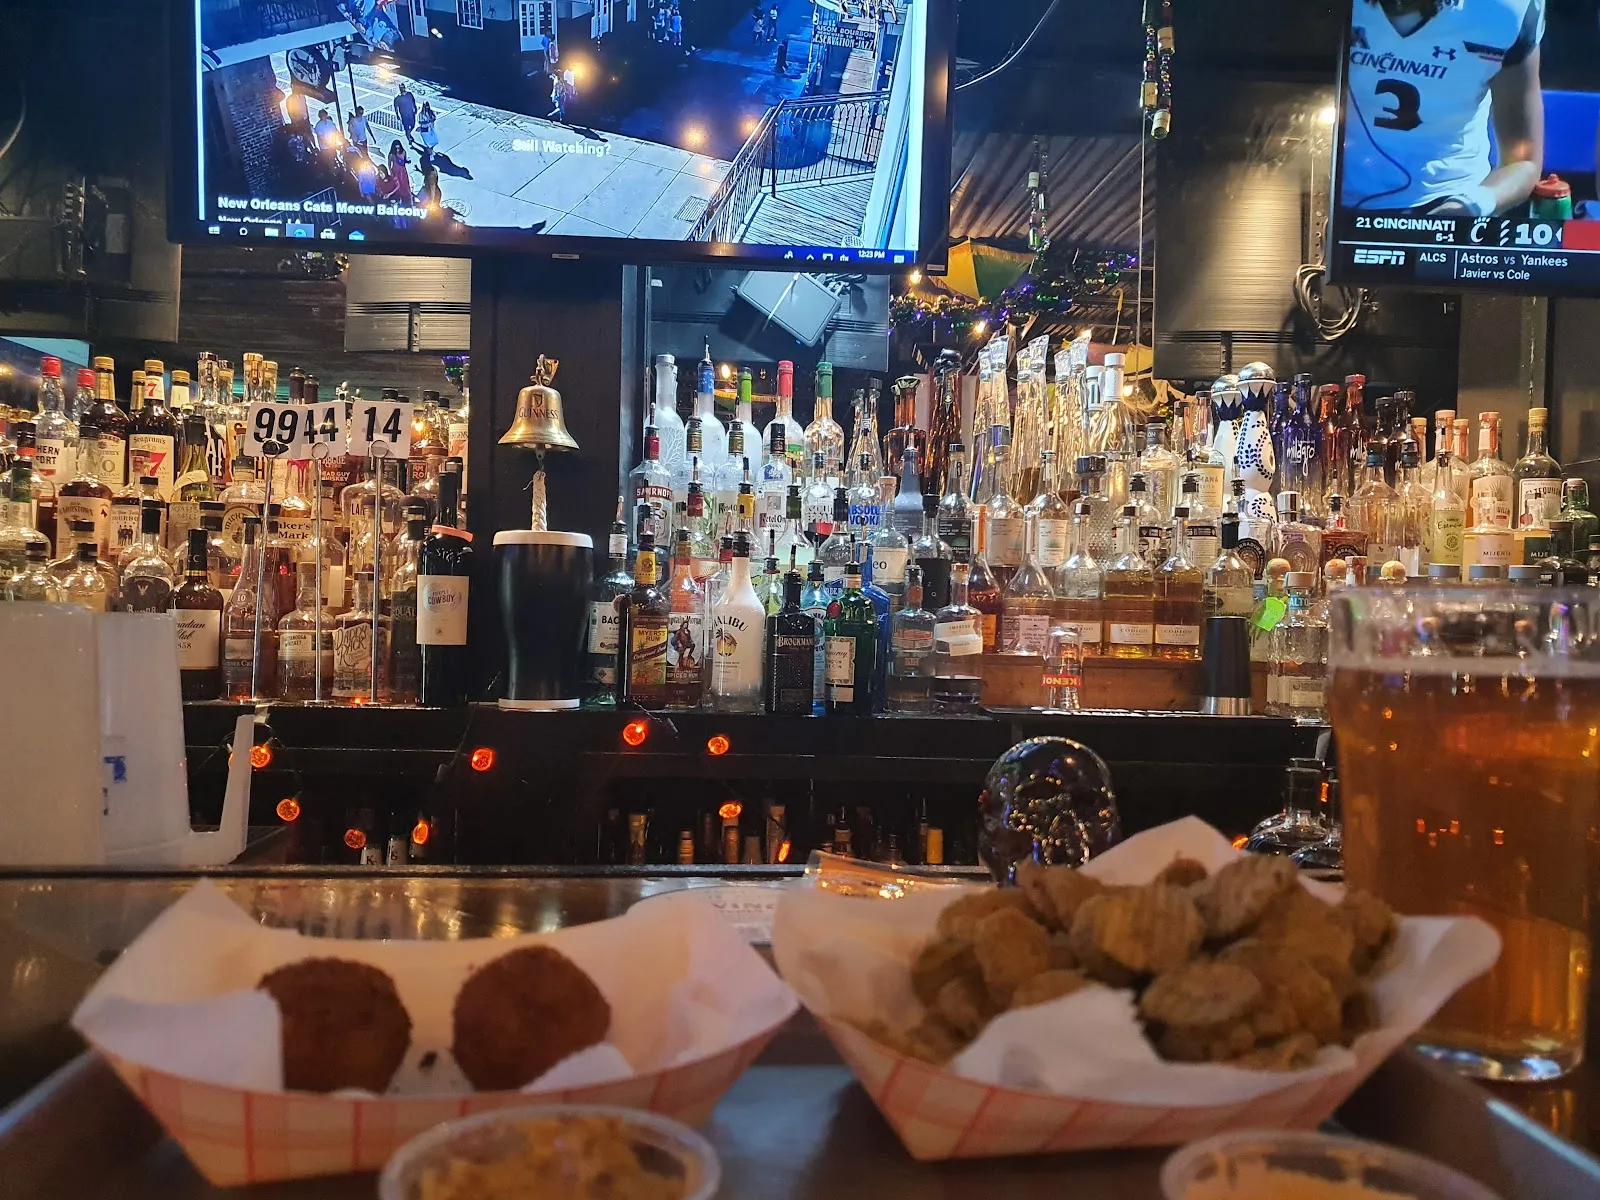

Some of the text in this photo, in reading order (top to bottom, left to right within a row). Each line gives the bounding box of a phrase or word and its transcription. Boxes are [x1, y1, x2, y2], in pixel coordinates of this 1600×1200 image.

[814, 25, 838, 33] AISON
[1350, 51, 1448, 79] CINCINNATI
[1374, 79, 1423, 131] 3
[513, 139, 611, 157] Still Watching?
[218, 197, 428, 220] New Orleans Cats Meow Balcony
[1355, 217, 1455, 232] 21 CINCINNATI
[1436, 233, 1454, 242] 6-1
[1515, 223, 1553, 245] 10
[874, 251, 885, 259] PM
[1353, 249, 1568, 267] ESPN ALCS Astros vs Yankees
[1460, 268, 1530, 280] Javier vs Cole
[147, 383, 158, 396] 7
[518, 406, 559, 419] GUINNESS
[253, 407, 298, 444] 99
[363, 407, 402, 443] 14
[133, 436, 166, 445] Seagram's
[37, 445, 60, 456] HERN
[1350, 438, 1367, 460] mila
[36, 455, 57, 465] FORT
[1286, 438, 1315, 477] milagro
[636, 486, 672, 499] SRNOFF
[848, 505, 881, 515] ABSOLU
[278, 522, 311, 530] aker's
[278, 531, 308, 540] Mark
[236, 594, 246, 602] 10
[427, 594, 455, 604] COWBOY
[176, 619, 206, 630] nadian
[669, 616, 684, 625] ptain
[177, 630, 195, 641] lub
[777, 637, 813, 648] BROCKMAN
[1046, 676, 1077, 686] KENO
